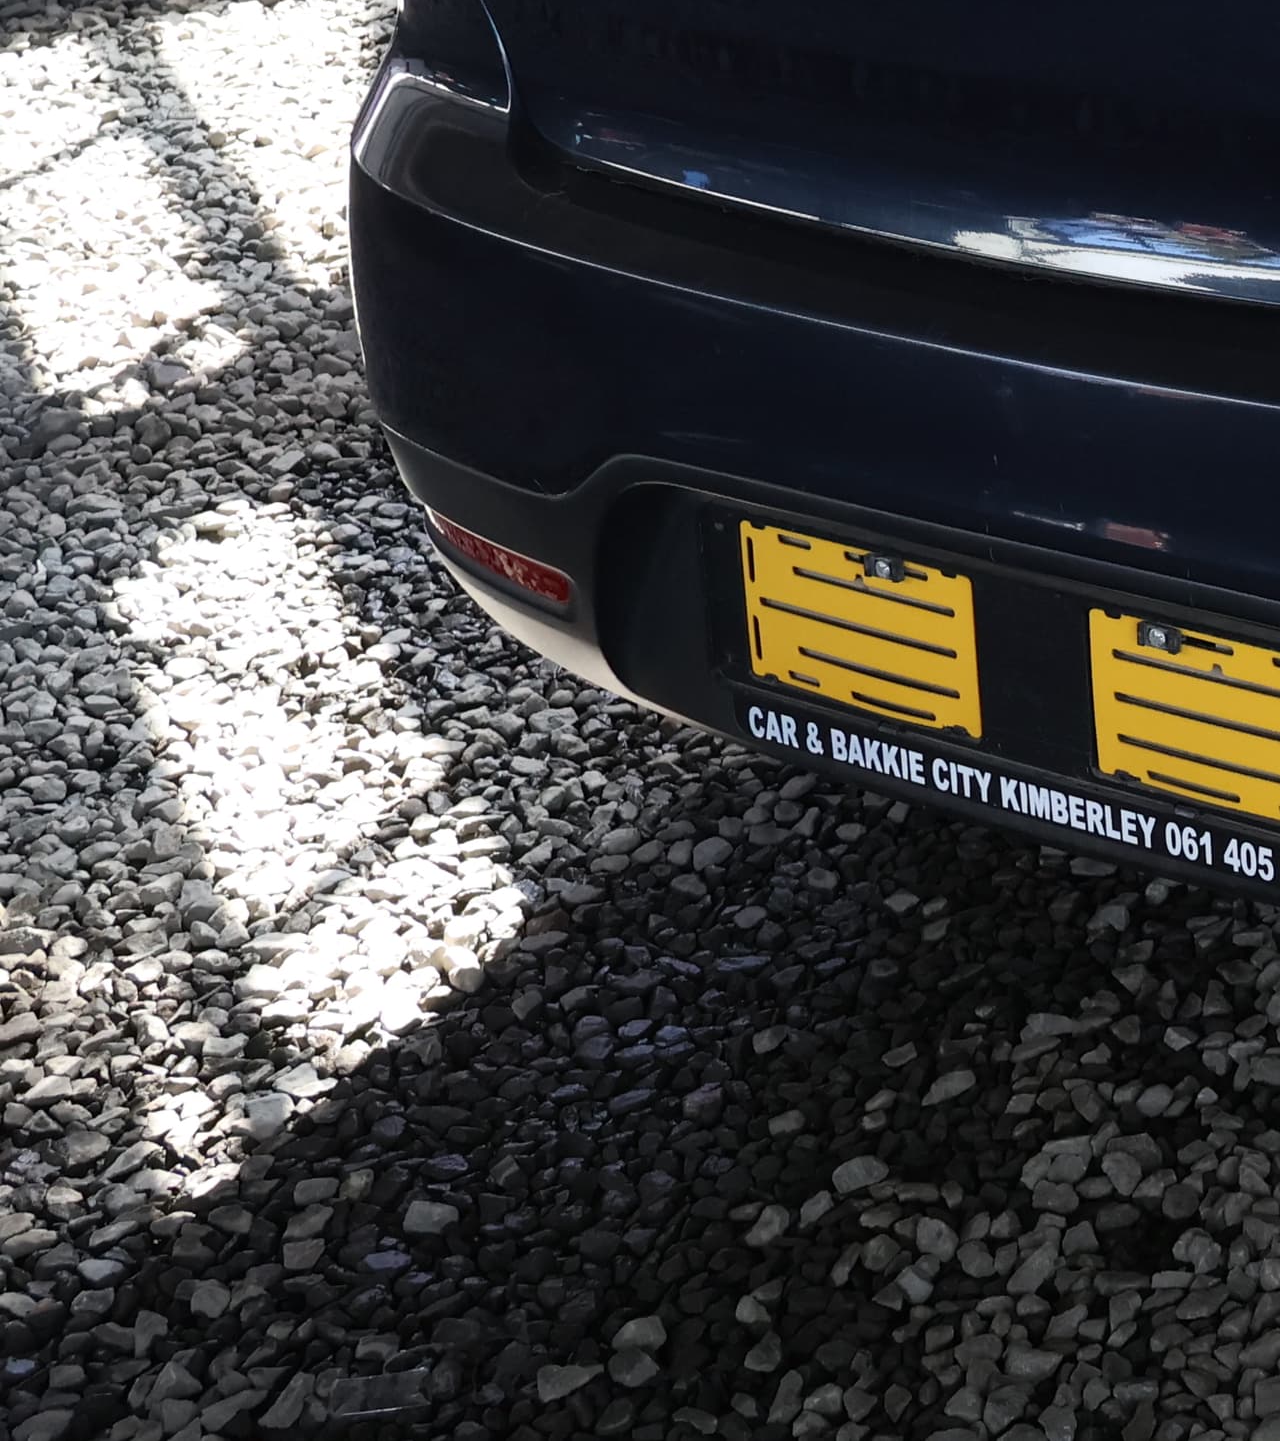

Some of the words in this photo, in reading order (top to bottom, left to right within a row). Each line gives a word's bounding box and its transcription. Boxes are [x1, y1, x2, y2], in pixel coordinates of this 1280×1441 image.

[748, 706, 799, 749] CAR
[806, 722, 824, 755] &
[830, 728, 926, 785] BAKKIE
[932, 757, 992, 803] CITY
[999, 776, 1156, 849] KIMBERLEY
[1165, 821, 1213, 866] 061
[1223, 838, 1275, 882] 405
